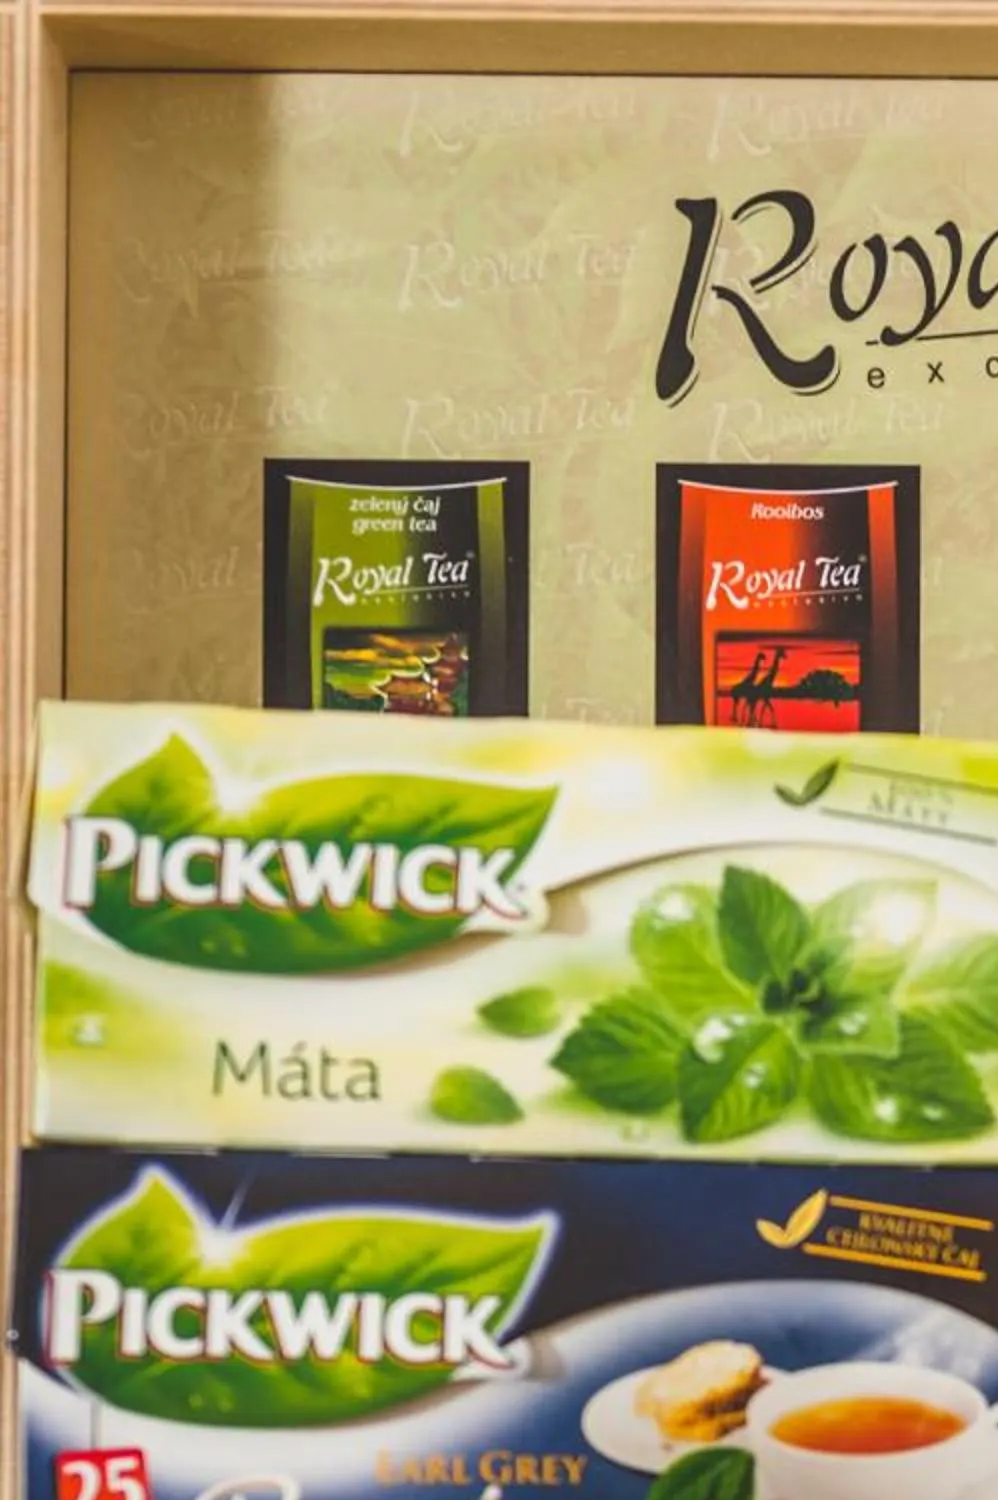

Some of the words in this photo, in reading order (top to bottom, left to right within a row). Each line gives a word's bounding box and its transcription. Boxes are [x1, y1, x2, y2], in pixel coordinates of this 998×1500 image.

[349, 496, 409, 514] zelený
[413, 496, 441, 516] čaj
[352, 518, 403, 535] green
[409, 517, 437, 532] tea
[748, 503, 825, 520] Rooibos
[312, 556, 413, 608] Royal
[423, 553, 470, 584] Tea
[706, 560, 806, 610] Royal
[815, 556, 861, 588] Tea
[63, 814, 530, 918] PICKWICK
[211, 1038, 383, 1101] Máta
[44, 1267, 516, 1370] PICKWICK
[374, 1446, 471, 1488] EARL
[478, 1450, 589, 1487] GREY
